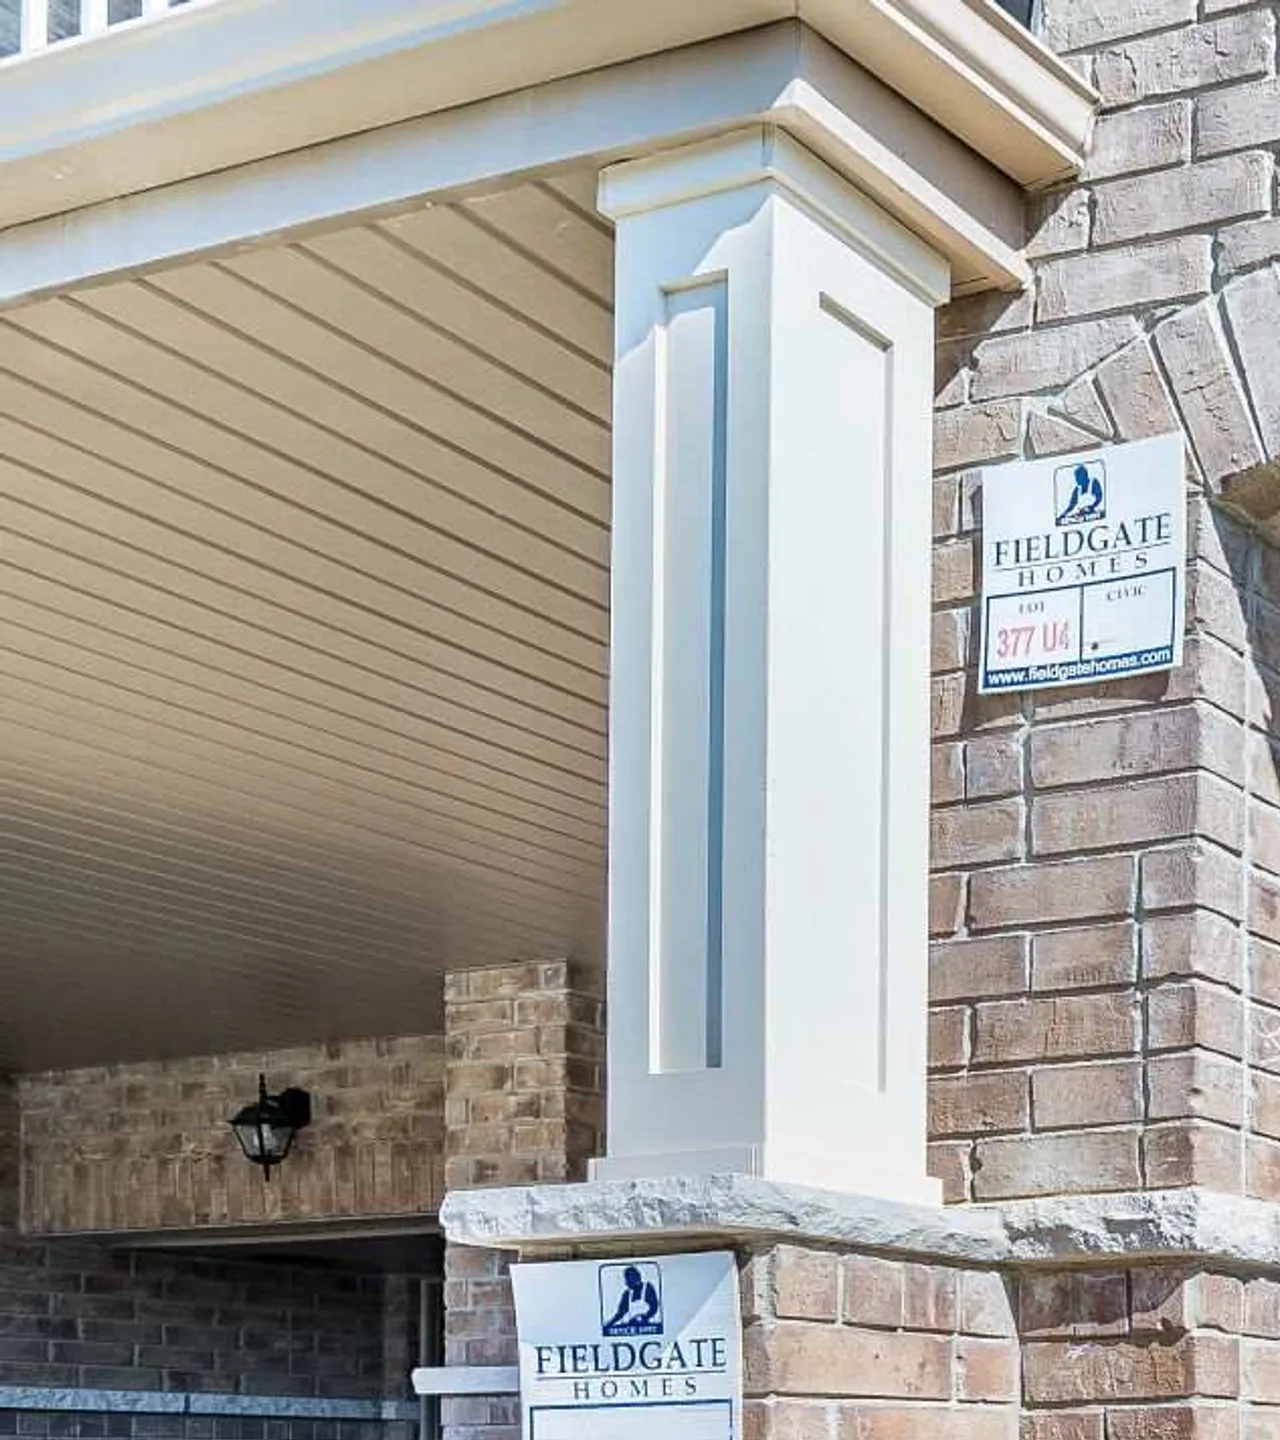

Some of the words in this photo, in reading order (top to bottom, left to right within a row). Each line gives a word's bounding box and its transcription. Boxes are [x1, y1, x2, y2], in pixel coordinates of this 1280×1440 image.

[992, 513, 1173, 566] FIELDGATE
[1018, 553, 1149, 588] HOMES
[1106, 584, 1148, 601] CIVIC
[997, 625, 1036, 659] 377
[986, 648, 1171, 685] www.fieldgatehomes.com
[534, 1337, 727, 1374] FIELDGATE
[573, 1376, 697, 1400] HOMES
